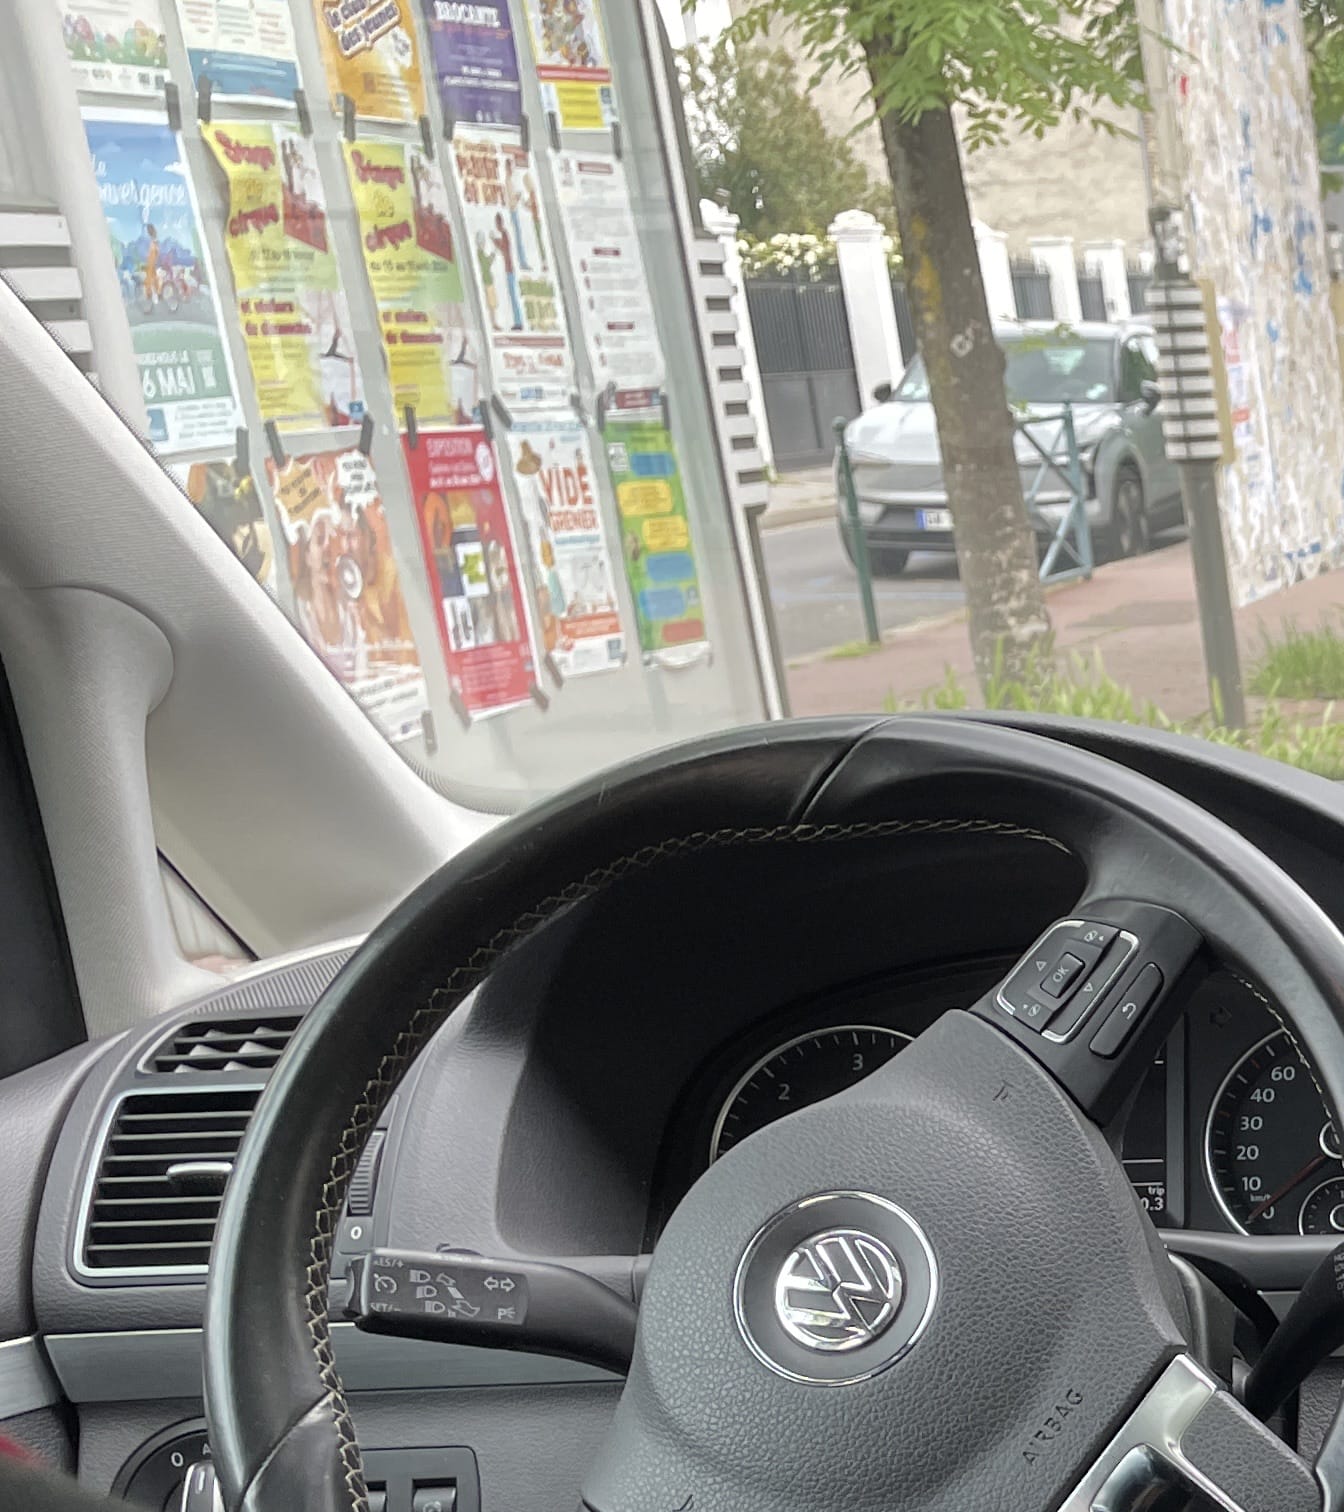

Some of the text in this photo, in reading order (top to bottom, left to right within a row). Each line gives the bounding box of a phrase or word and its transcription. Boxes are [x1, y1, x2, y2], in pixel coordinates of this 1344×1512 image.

[156, 363, 196, 397] MAI
[538, 463, 594, 507] VIDE
[1052, 966, 1070, 983] OK
[852, 1053, 864, 1071] 3
[1271, 1066, 1295, 1081] 60
[778, 1083, 790, 1101] 2
[1250, 1088, 1275, 1103] 40
[1240, 1116, 1263, 1131] 30
[1236, 1145, 1259, 1161] 20
[1242, 1176, 1261, 1191] 10
[1022, 1388, 1084, 1466] AIRBAG
